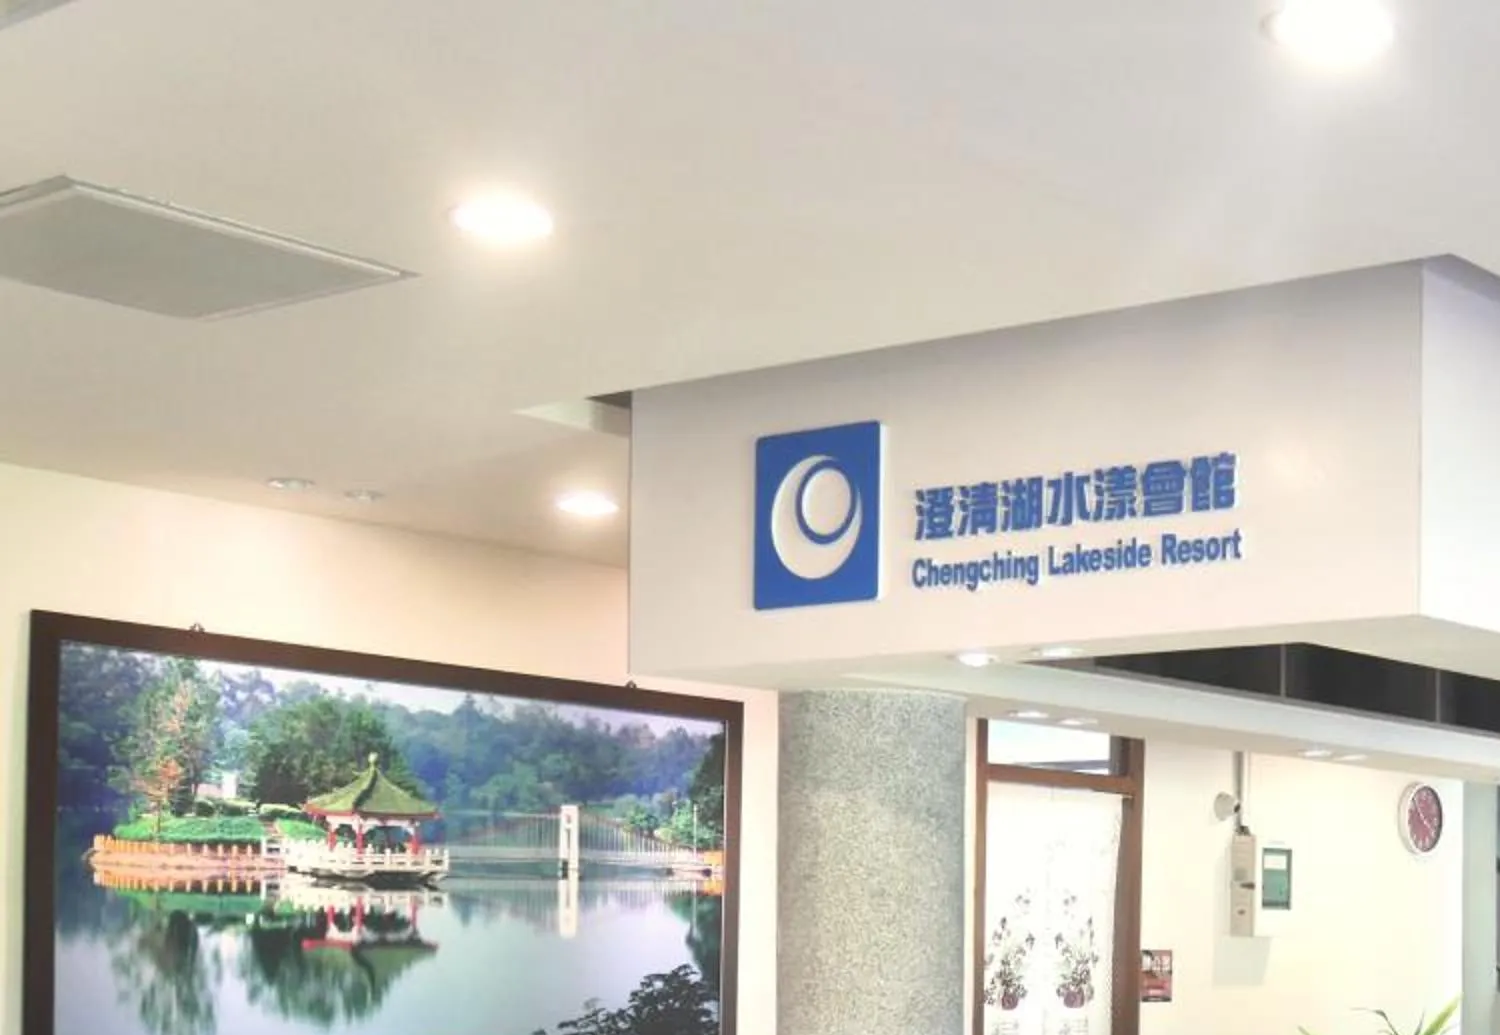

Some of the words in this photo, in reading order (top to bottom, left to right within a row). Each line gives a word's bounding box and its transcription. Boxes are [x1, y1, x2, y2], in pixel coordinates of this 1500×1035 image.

[914, 451, 1237, 541] 澄清湖水漾會館
[912, 551, 1039, 592] Chengching
[1048, 537, 1152, 576] Lakeside
[1160, 527, 1243, 566] Resort
